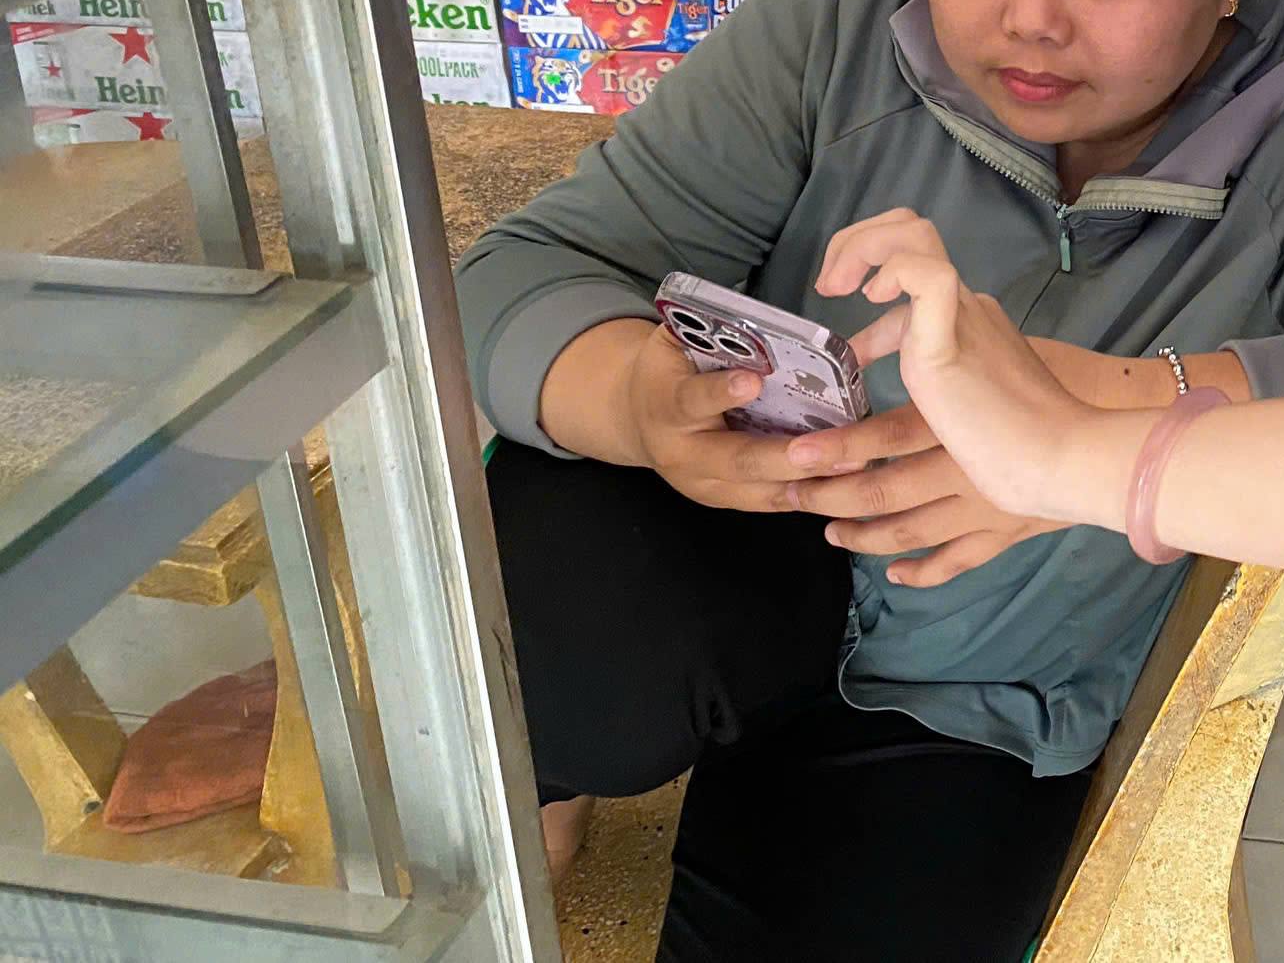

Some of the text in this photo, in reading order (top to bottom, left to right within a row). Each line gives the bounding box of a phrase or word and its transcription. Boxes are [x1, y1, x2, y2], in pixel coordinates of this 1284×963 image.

[418, 57, 480, 78] OOLPACK
[94, 76, 165, 106] Hein
[598, 66, 655, 107] Tige
